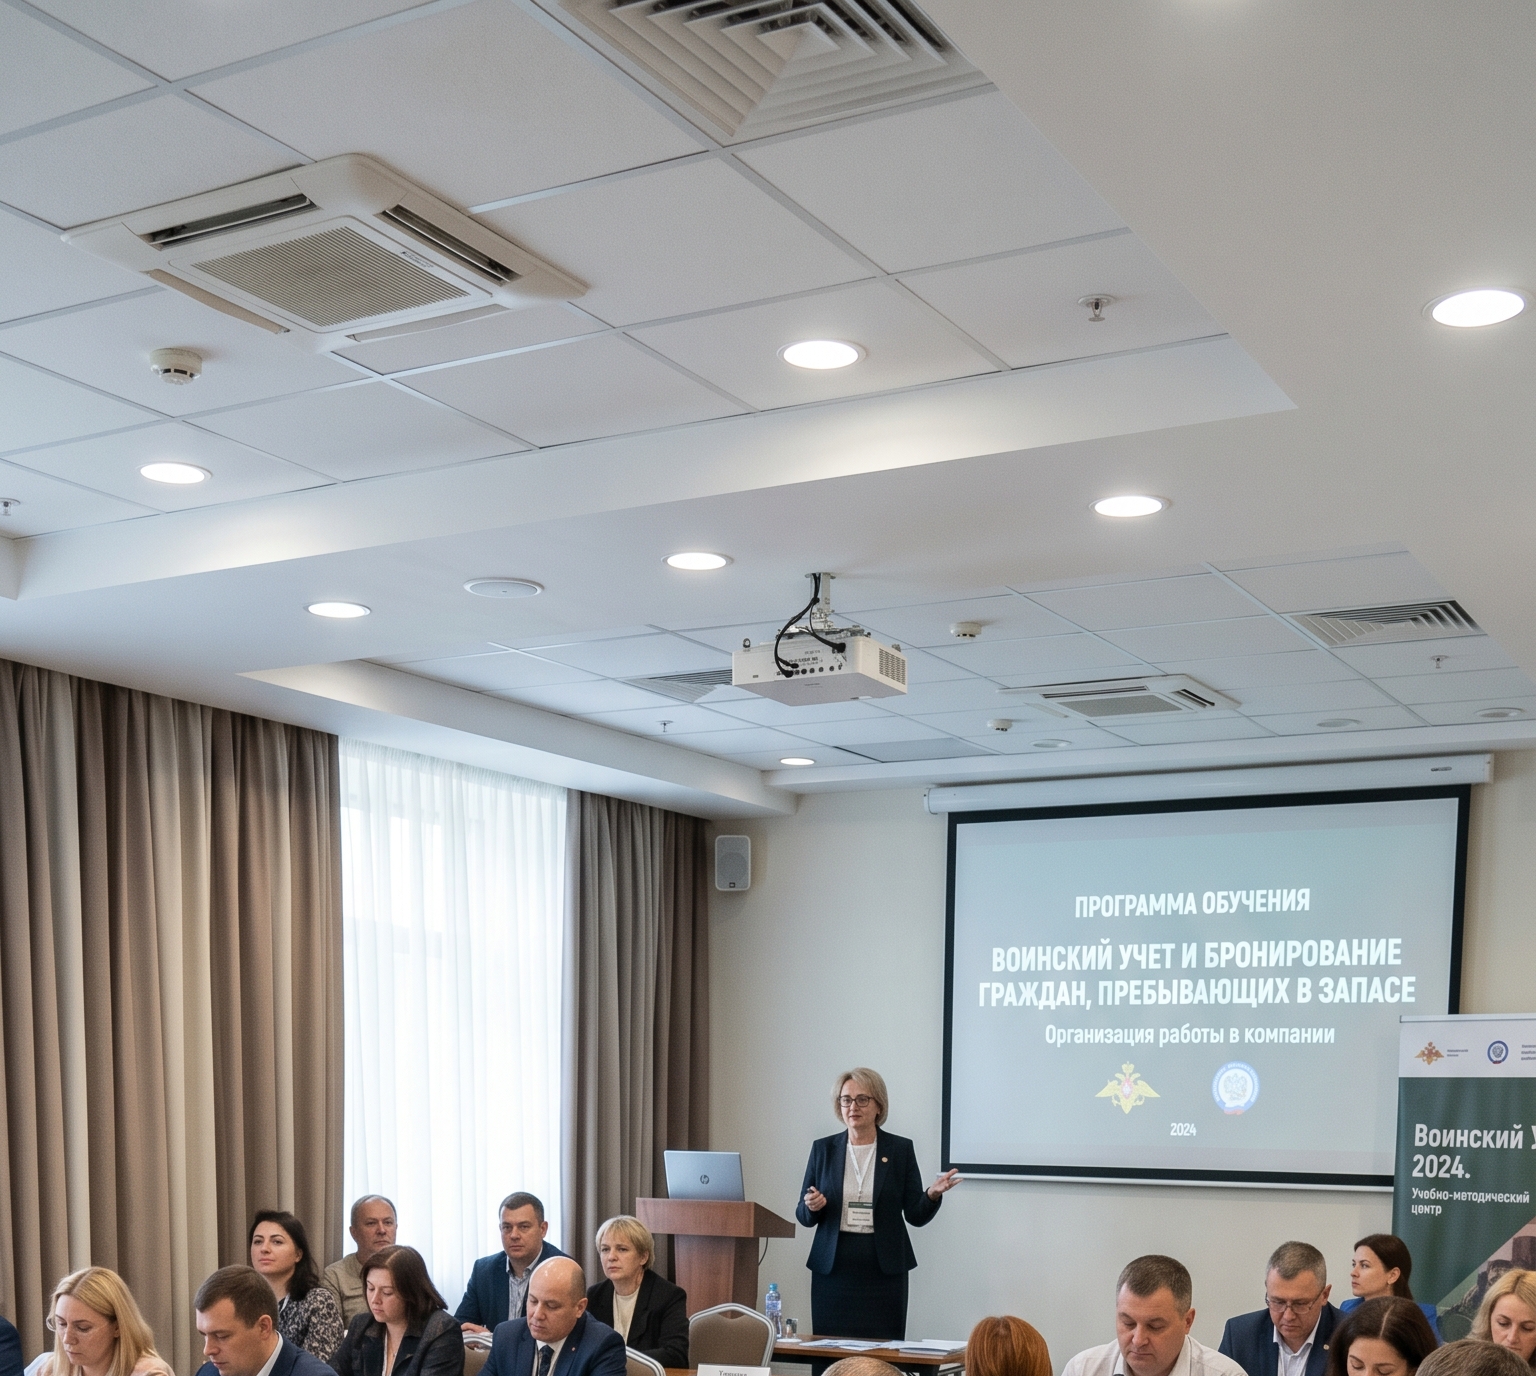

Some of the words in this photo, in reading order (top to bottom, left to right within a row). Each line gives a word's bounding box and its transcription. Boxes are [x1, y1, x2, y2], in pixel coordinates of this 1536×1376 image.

[1075, 892, 1197, 918] ПРОГРАММА
[1203, 888, 1310, 914] ОБУЧЕНИЯ
[992, 938, 1112, 972] ВОИНСКИЙ
[1119, 944, 1175, 970] УЧЕТ
[1182, 943, 1197, 968] И
[1205, 938, 1402, 968] БРОНИРОВАНИЕ
[979, 980, 1092, 1010] ГРАЖДАН,
[1098, 977, 1290, 1008] ПРЕБЫВАЮЩИХ
[1297, 978, 1311, 1003] В
[1318, 976, 1415, 1003] ЗАПАСЕ
[1045, 1024, 1154, 1048] Организация
[1159, 1022, 1224, 1048] работы
[1230, 1027, 1239, 1043] в
[1244, 1027, 1335, 1044] компании
[1170, 1122, 1197, 1137] 2024
[1414, 1123, 1524, 1150] Воинский
[1411, 1153, 1471, 1179] 2024.
